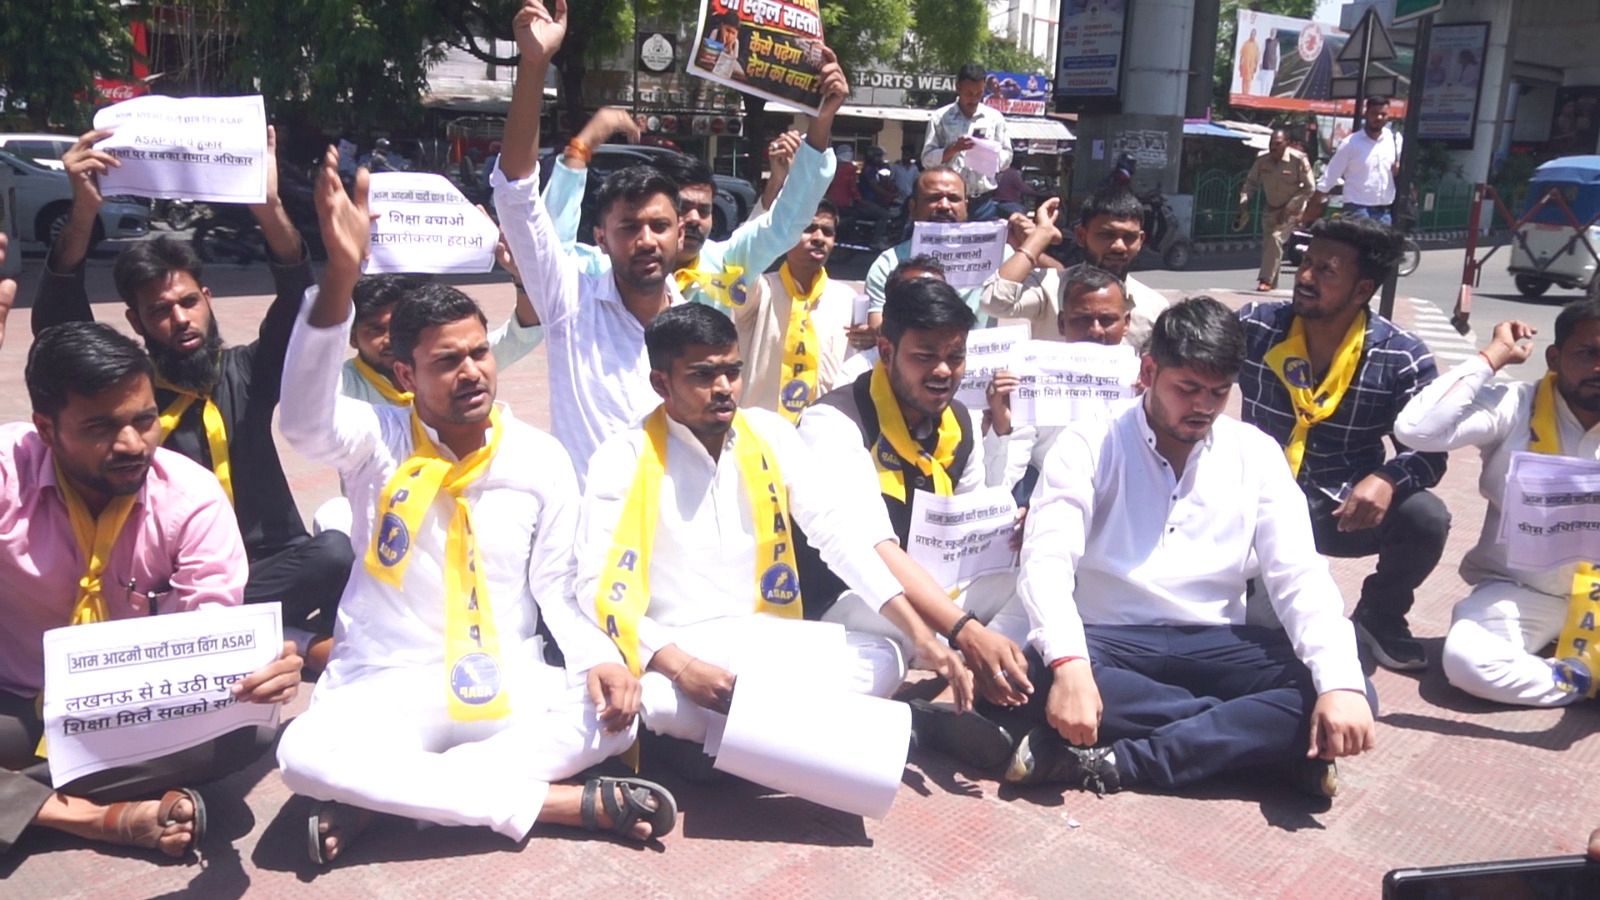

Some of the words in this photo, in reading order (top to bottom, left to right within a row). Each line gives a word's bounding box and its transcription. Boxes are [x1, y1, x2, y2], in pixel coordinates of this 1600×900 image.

[749, 31, 773, 56] कैसे
[747, 53, 769, 78] देश
[769, 64, 787, 83] का
[213, 152, 253, 166] अधिकार
[389, 210, 421, 225] शिक्षा
[425, 212, 465, 227] बचाओ
[447, 233, 483, 248] हटाओ
[766, 588, 794, 600] ASAP
[71, 654, 99, 670] आम
[103, 645, 142, 666] आदमी
[144, 641, 169, 661] पार्टी
[171, 642, 195, 658] छात्र
[198, 635, 218, 653] विंग
[221, 634, 253, 648] ASAP
[65, 689, 133, 712] लखनऊ
[139, 681, 153, 701] से
[160, 679, 172, 696] ये
[178, 673, 208, 694] उठी
[64, 717, 110, 736] शिक्षा
[116, 706, 152, 727] मिले
[157, 698, 208, 720] सबको
